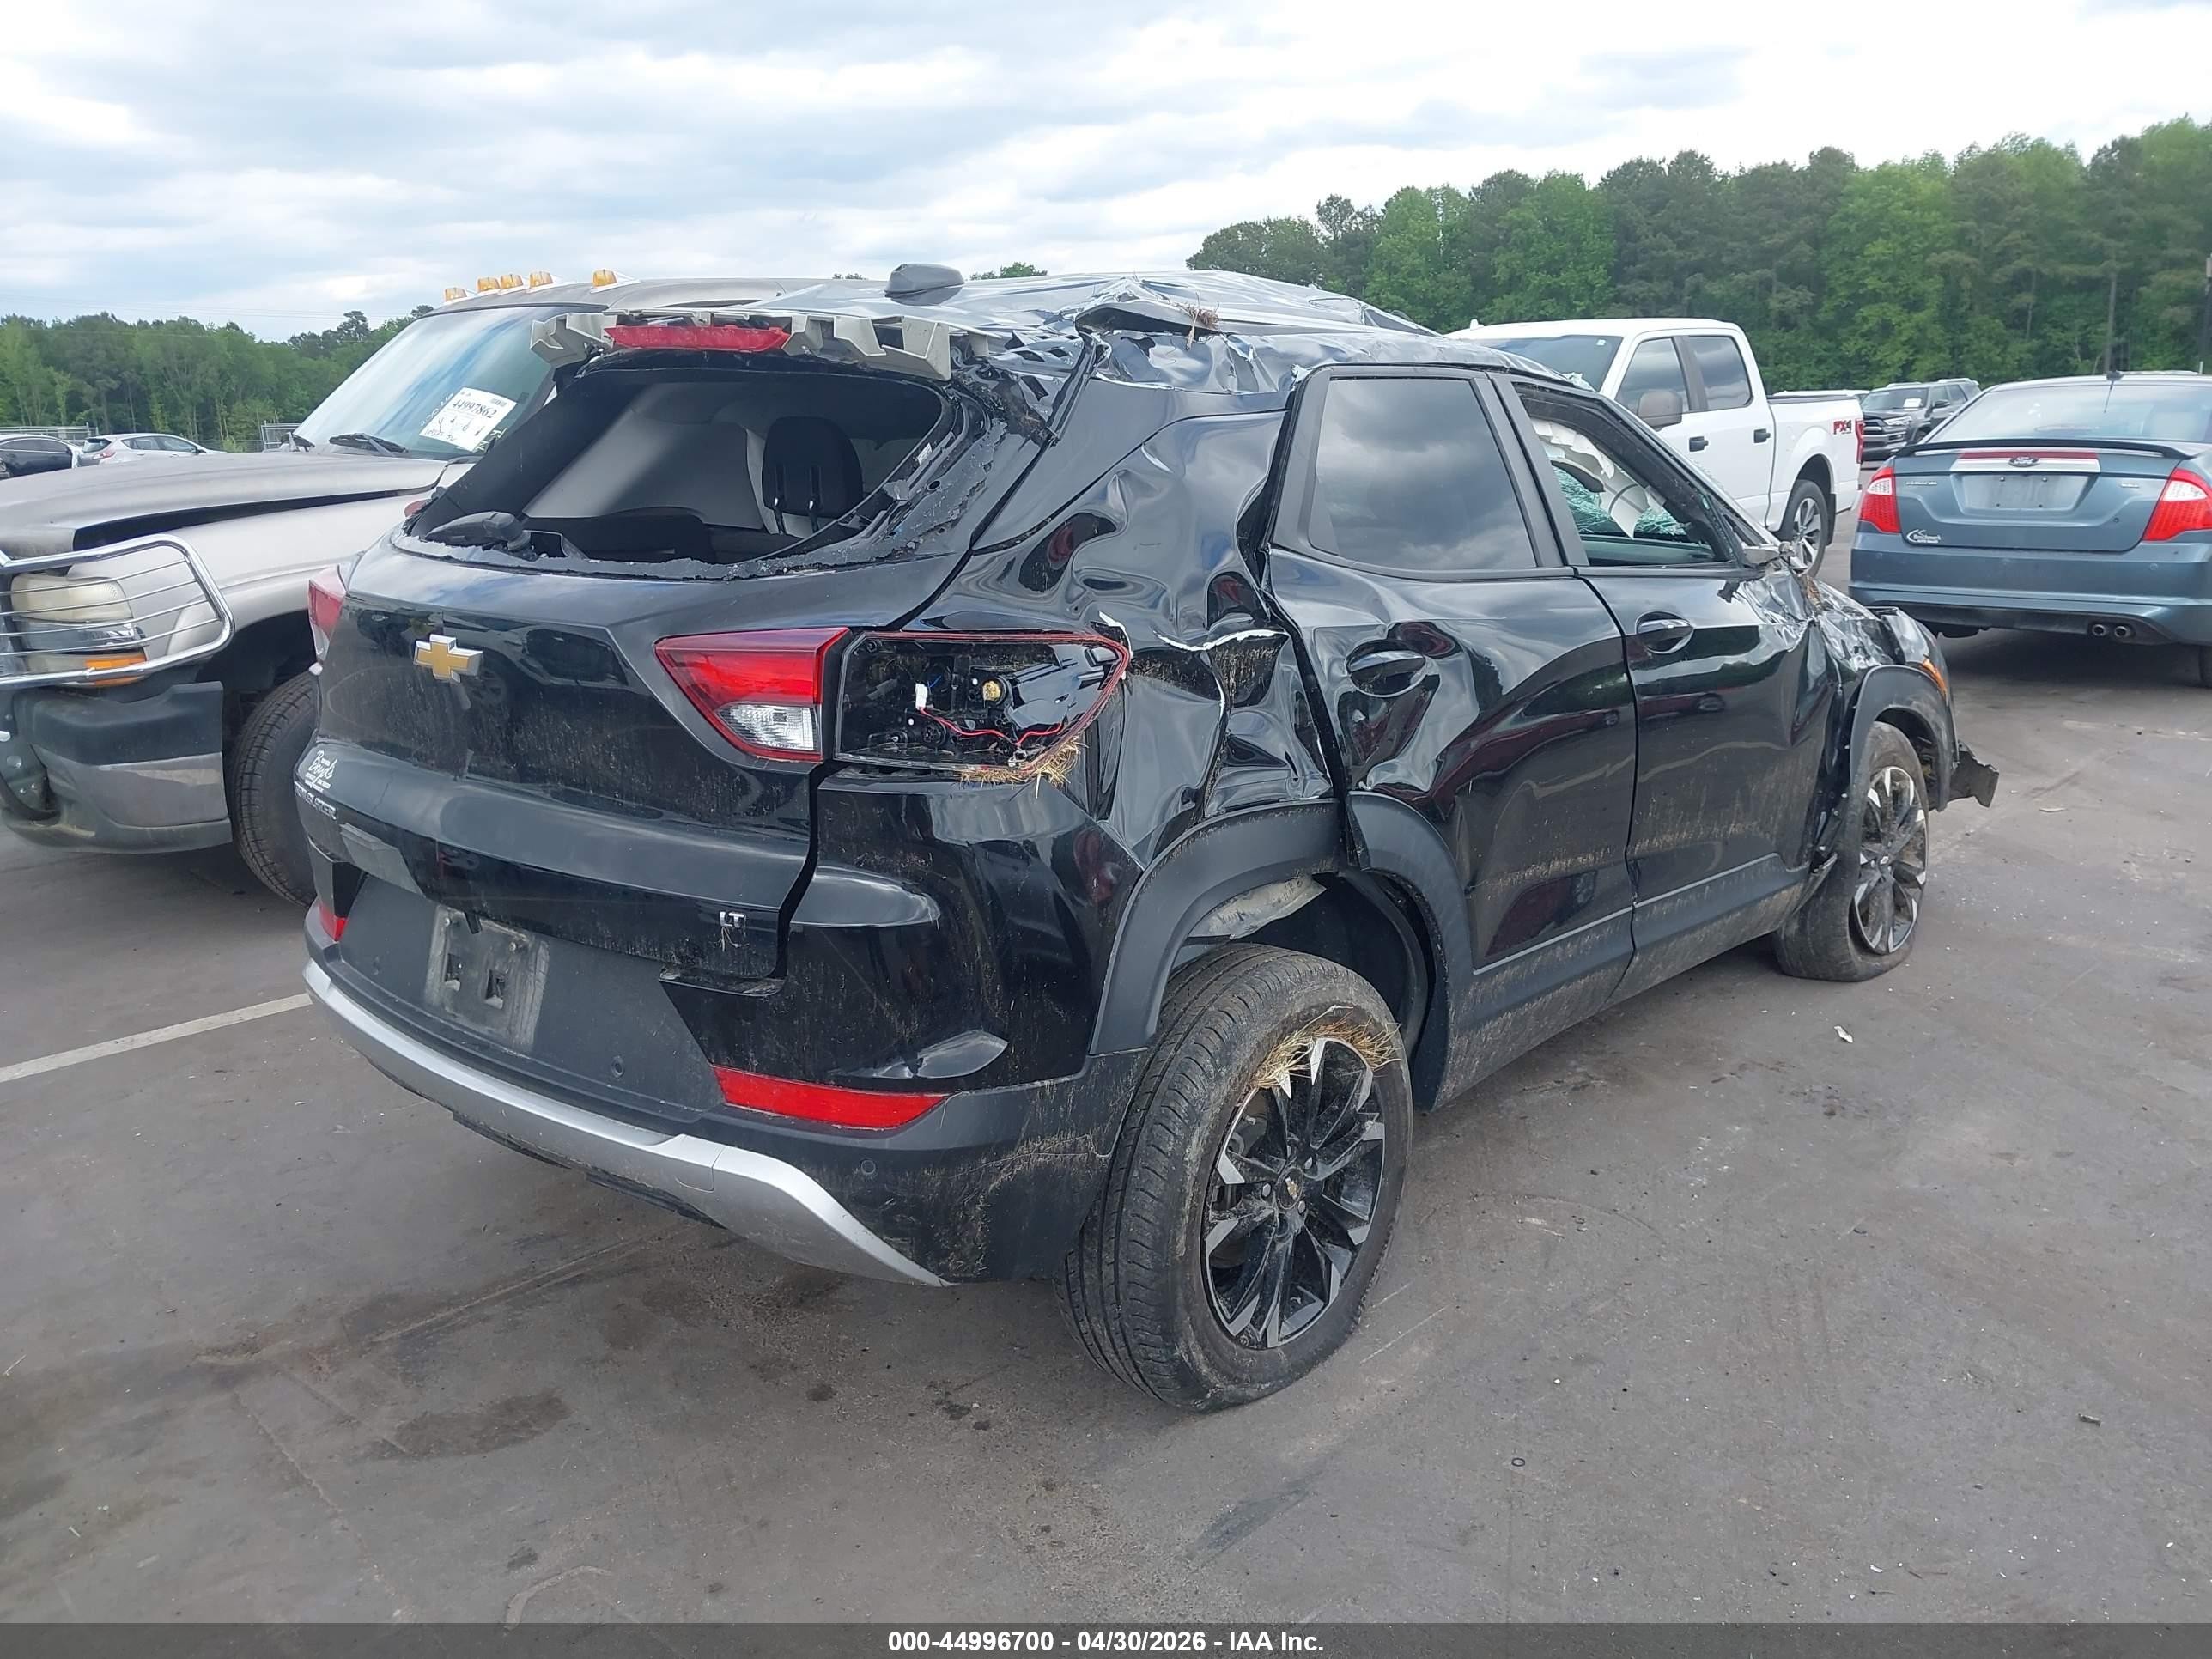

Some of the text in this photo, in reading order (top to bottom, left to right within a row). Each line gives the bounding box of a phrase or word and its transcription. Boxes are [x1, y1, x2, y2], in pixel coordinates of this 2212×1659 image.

[453, 399, 498, 419] 44997862
[1833, 420, 1852, 434] FX4
[720, 911, 745, 928] LT
